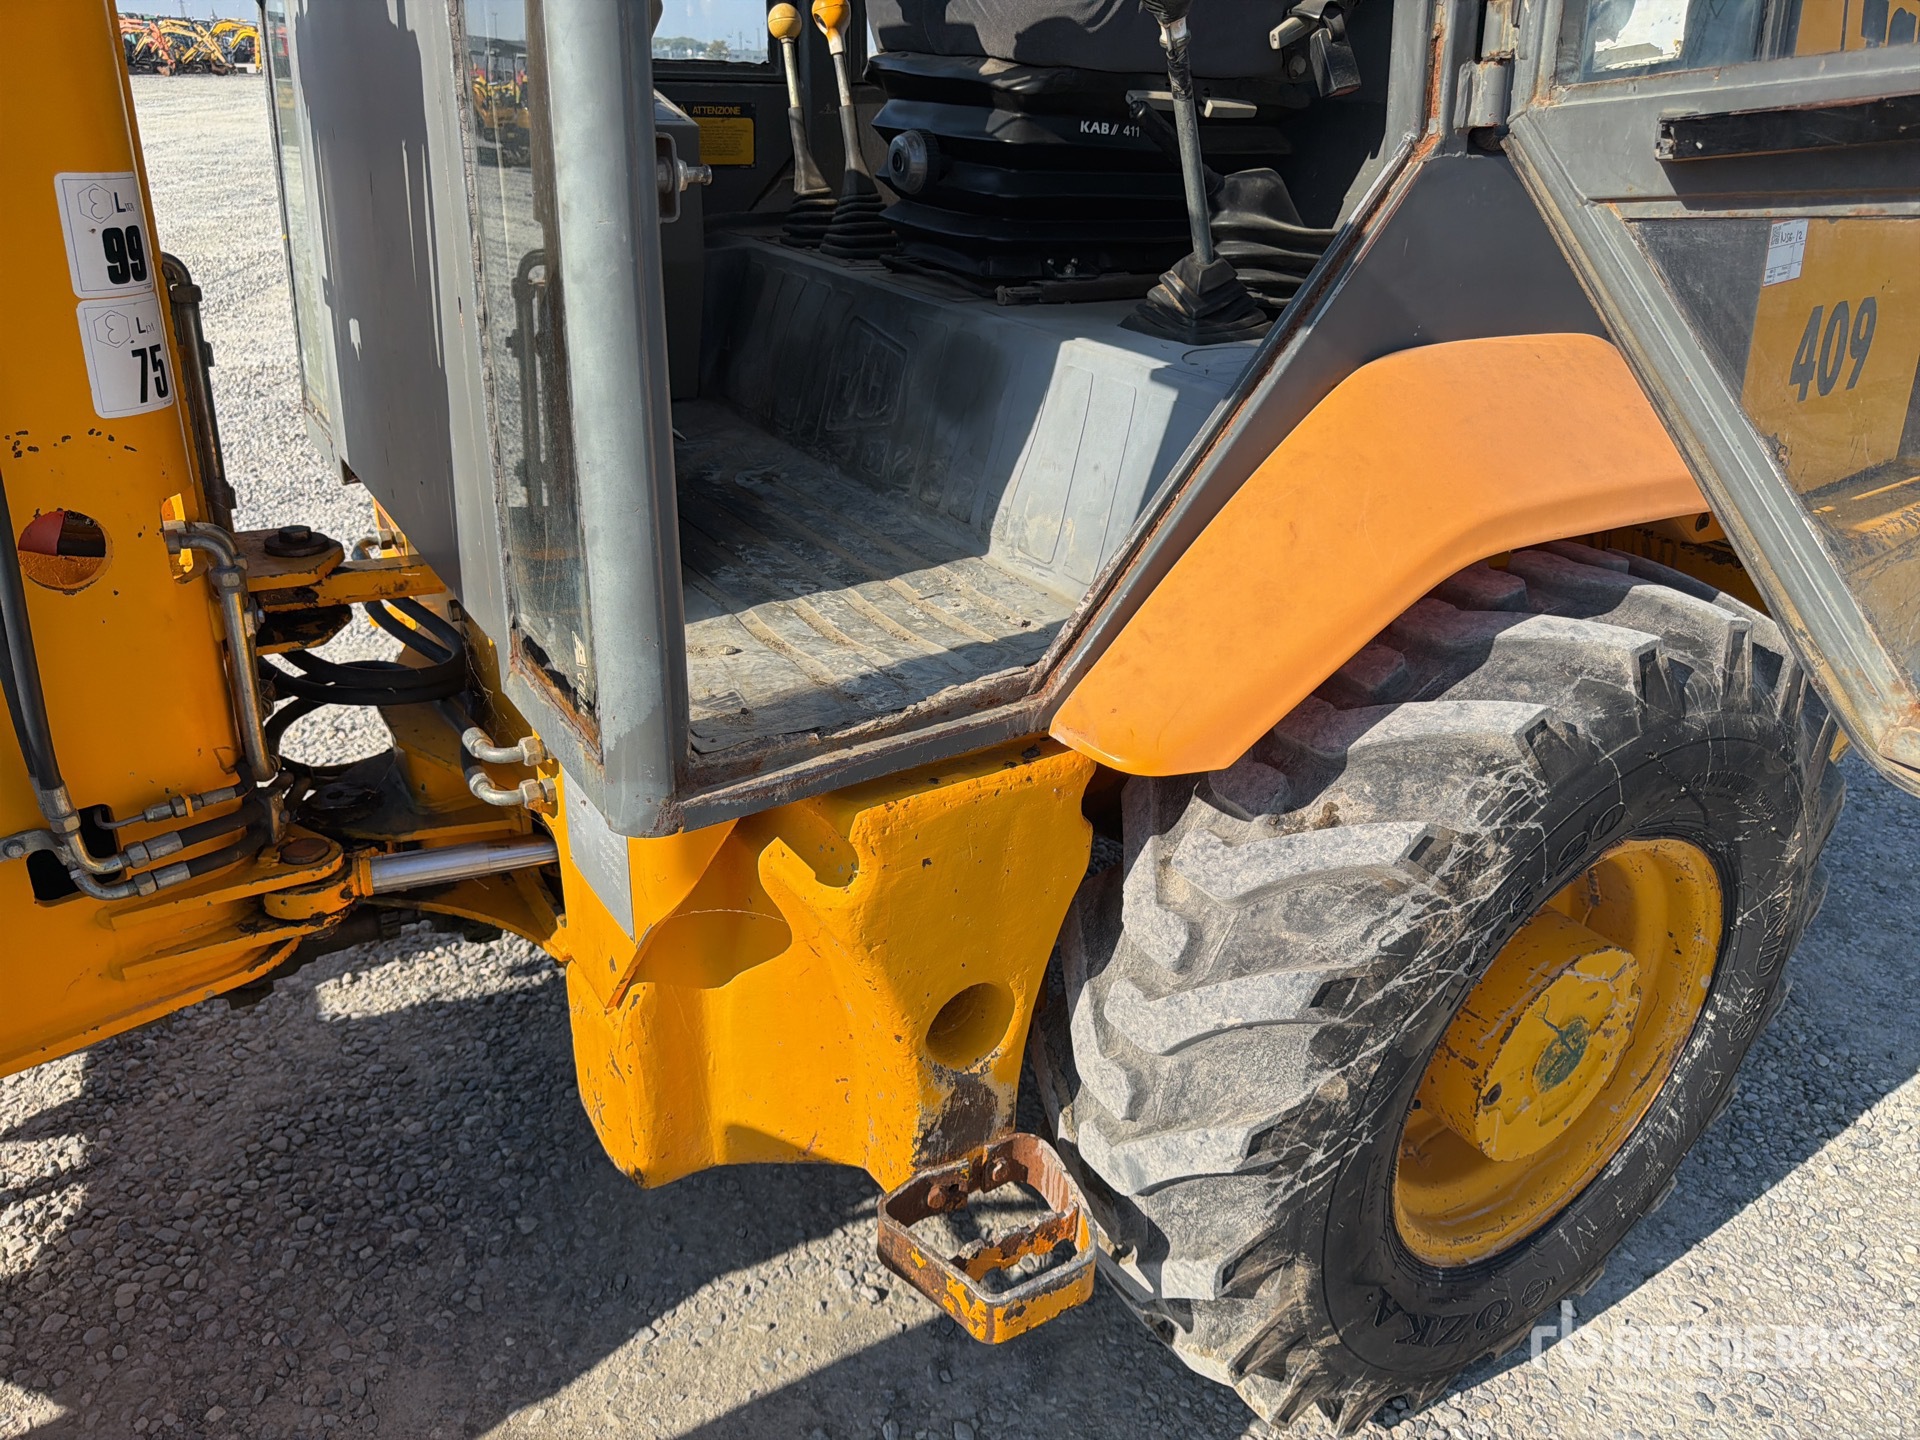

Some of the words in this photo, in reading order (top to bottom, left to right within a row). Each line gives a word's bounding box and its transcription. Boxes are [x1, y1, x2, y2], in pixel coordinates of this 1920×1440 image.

[692, 105, 741, 115] ATTENZIONE
[1123, 125, 1140, 138] 411
[101, 224, 148, 285] 99
[131, 343, 169, 404] 75
[1788, 296, 1878, 403] 409
[1372, 1286, 1515, 1348] ÖZKA
